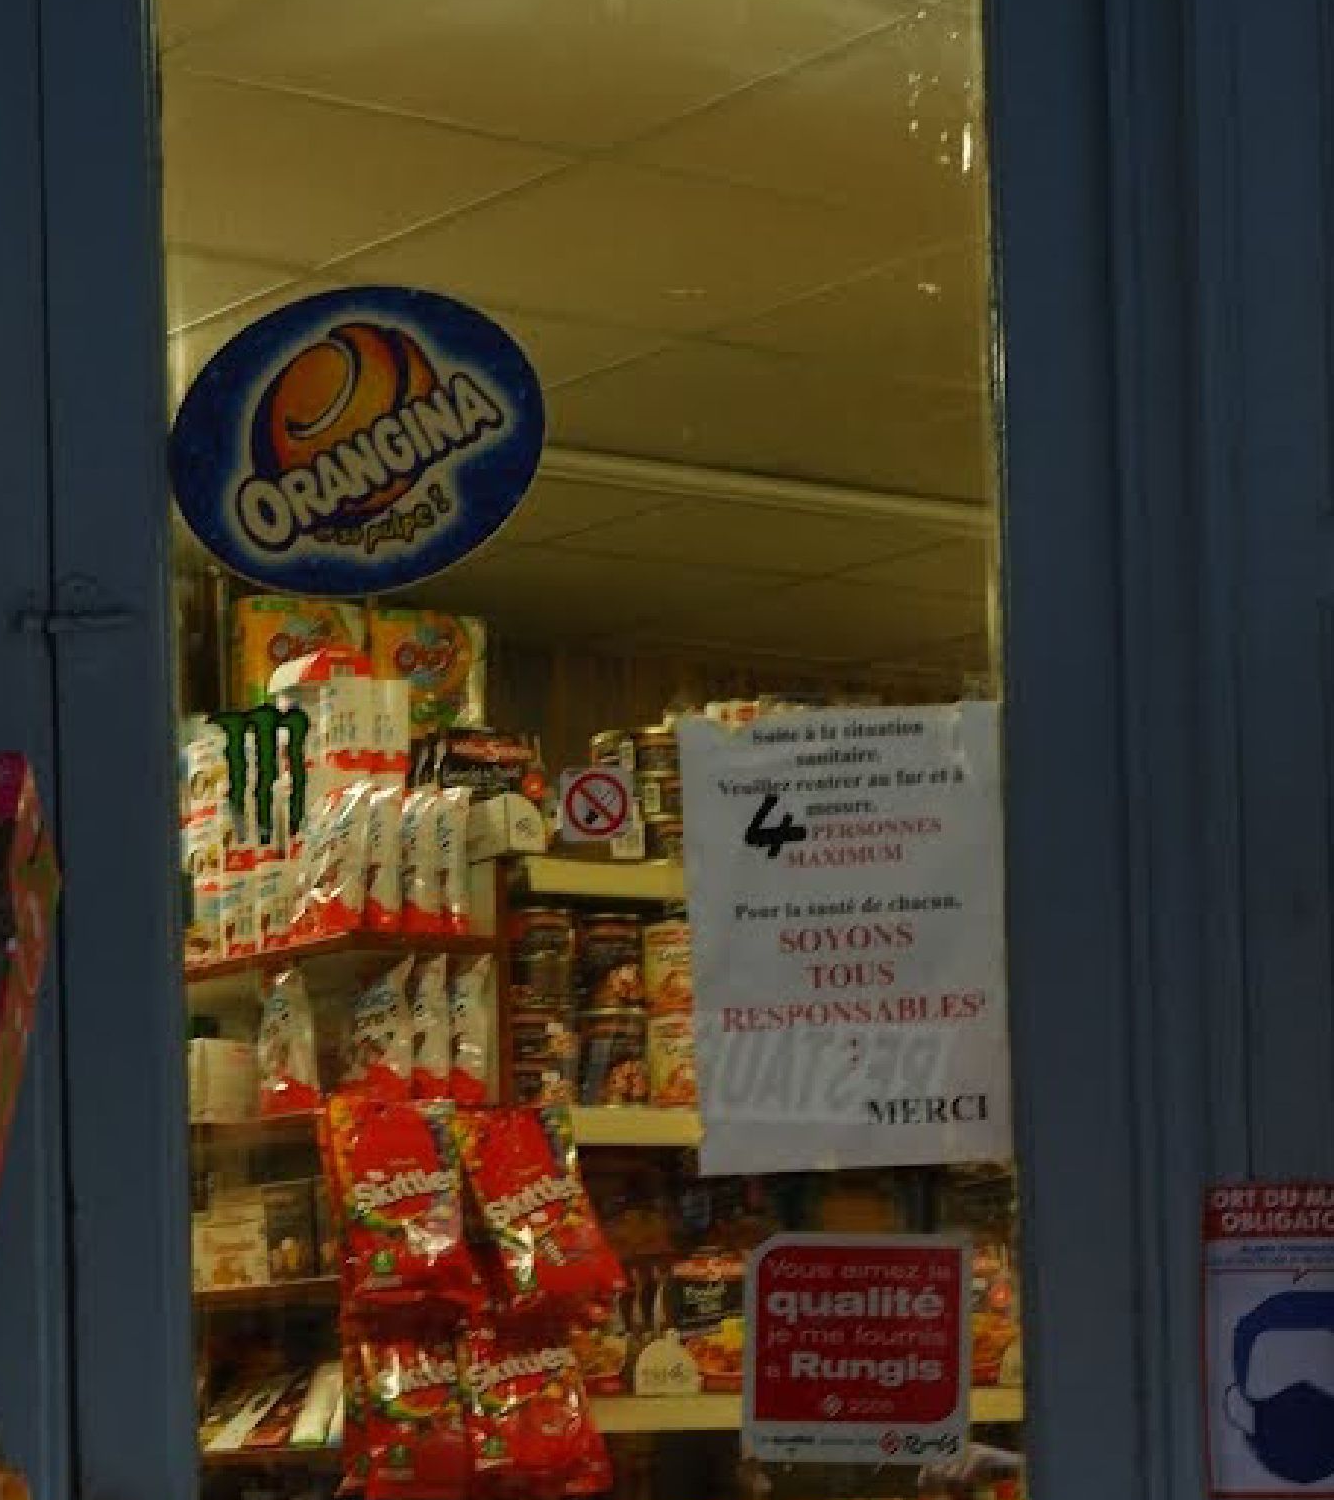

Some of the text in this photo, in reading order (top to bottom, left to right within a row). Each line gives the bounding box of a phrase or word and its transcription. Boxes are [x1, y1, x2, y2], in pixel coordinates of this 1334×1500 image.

[235, 372, 503, 551] ORANGINA
[744, 795, 807, 859] 4
[812, 817, 942, 840] PERSONNES
[787, 844, 903, 868] MAXIMUM
[779, 921, 915, 954] SOYONS
[801, 960, 896, 989] TOUS
[867, 1094, 988, 1125] MERCI
[1266, 1187, 1297, 1208] DU
[773, 1259, 833, 1280] Vous
[767, 1284, 945, 1325] qualité
